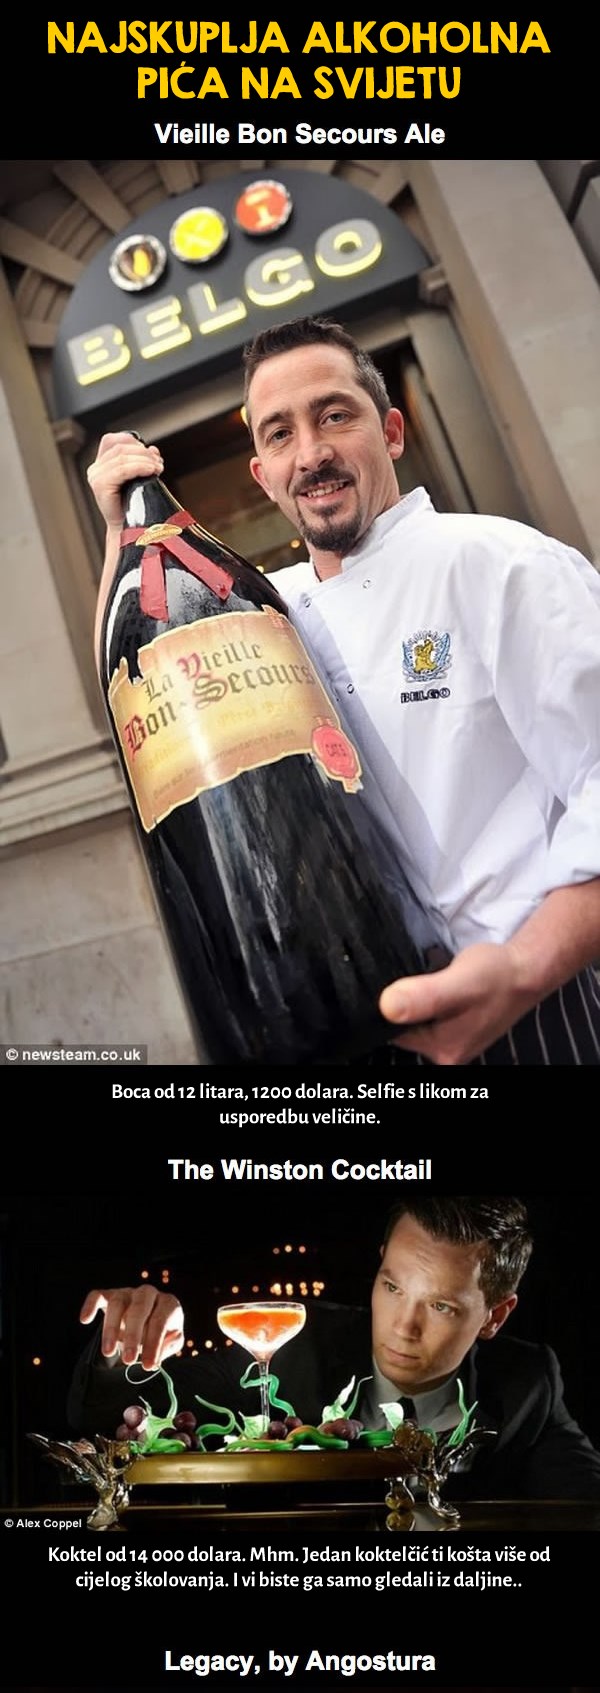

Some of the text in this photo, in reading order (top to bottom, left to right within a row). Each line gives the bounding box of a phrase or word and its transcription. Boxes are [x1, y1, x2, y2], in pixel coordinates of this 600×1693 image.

[66, 218, 383, 386] BELGO
[176, 641, 263, 681] Vieille
[400, 687, 451, 704] BELGO
